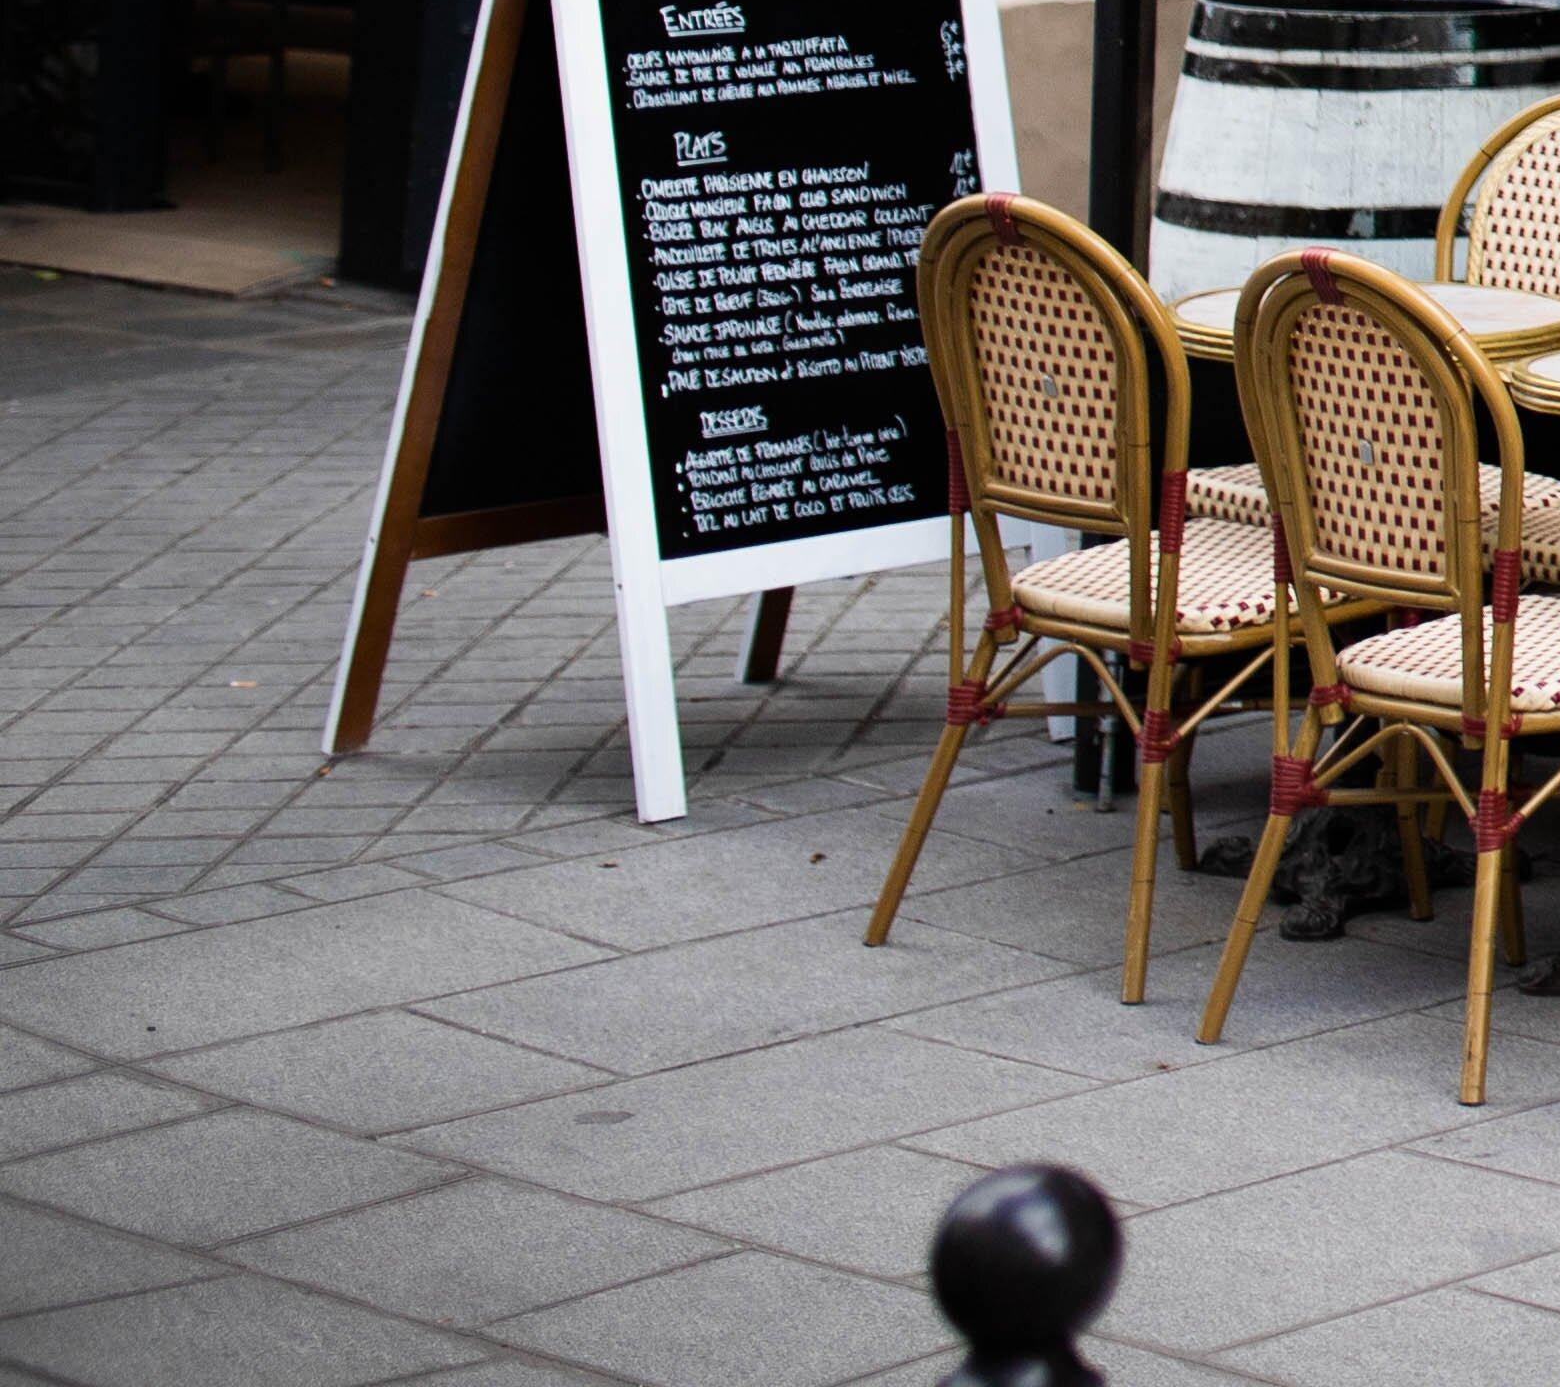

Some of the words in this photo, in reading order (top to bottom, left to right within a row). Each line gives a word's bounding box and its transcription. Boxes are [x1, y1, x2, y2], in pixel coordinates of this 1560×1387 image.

[673, 131, 727, 162] PLATS
[777, 169, 797, 187] EN
[831, 183, 908, 205] SANDWICH
[801, 209, 868, 230] CHEDDAR
